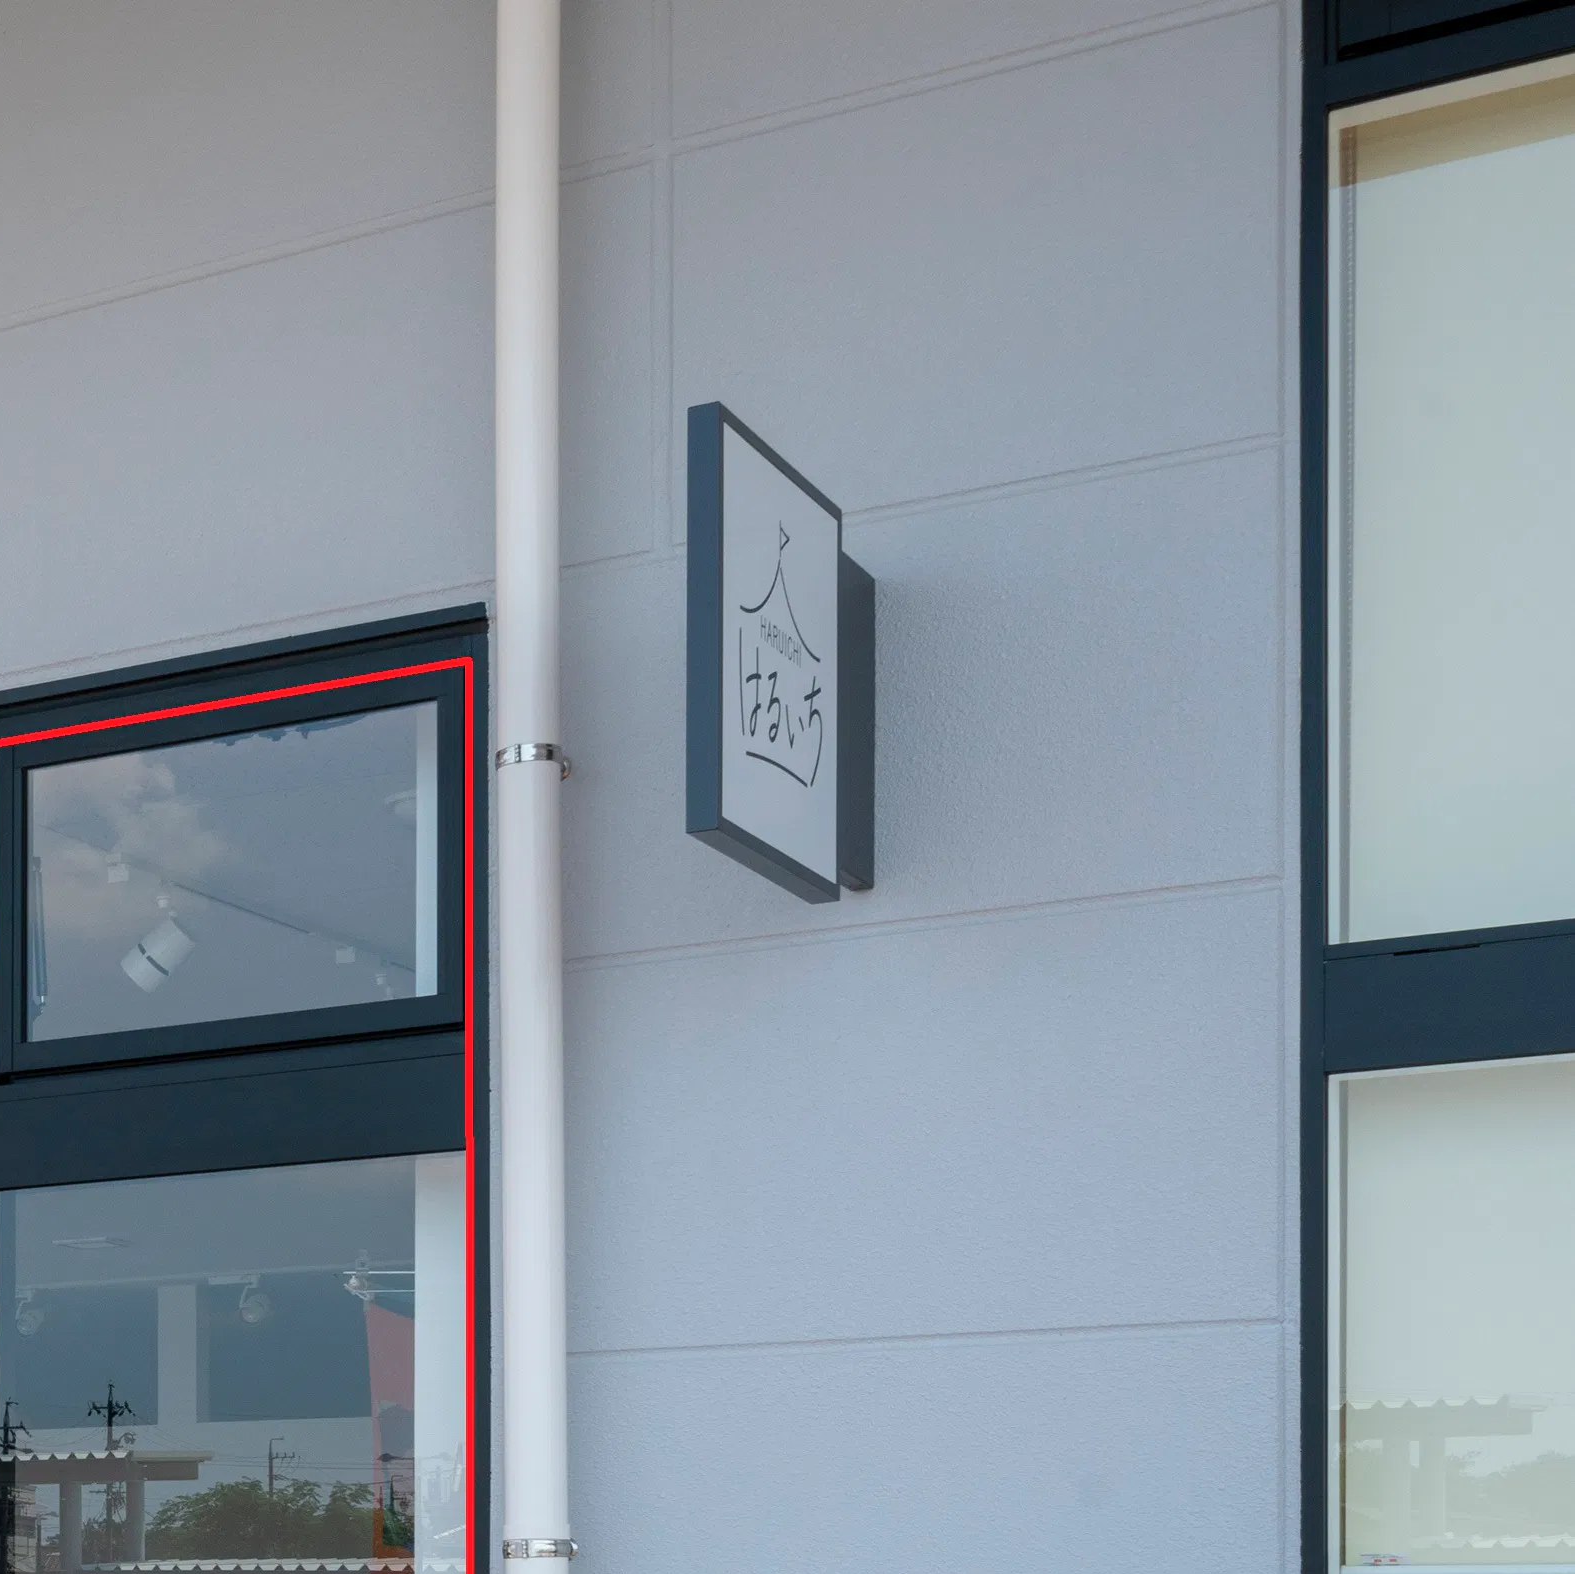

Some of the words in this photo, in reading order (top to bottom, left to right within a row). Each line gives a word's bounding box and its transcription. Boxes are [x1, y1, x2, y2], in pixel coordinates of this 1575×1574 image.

[760, 615, 802, 669] HARUICHI
[739, 626, 823, 788] はるいち
